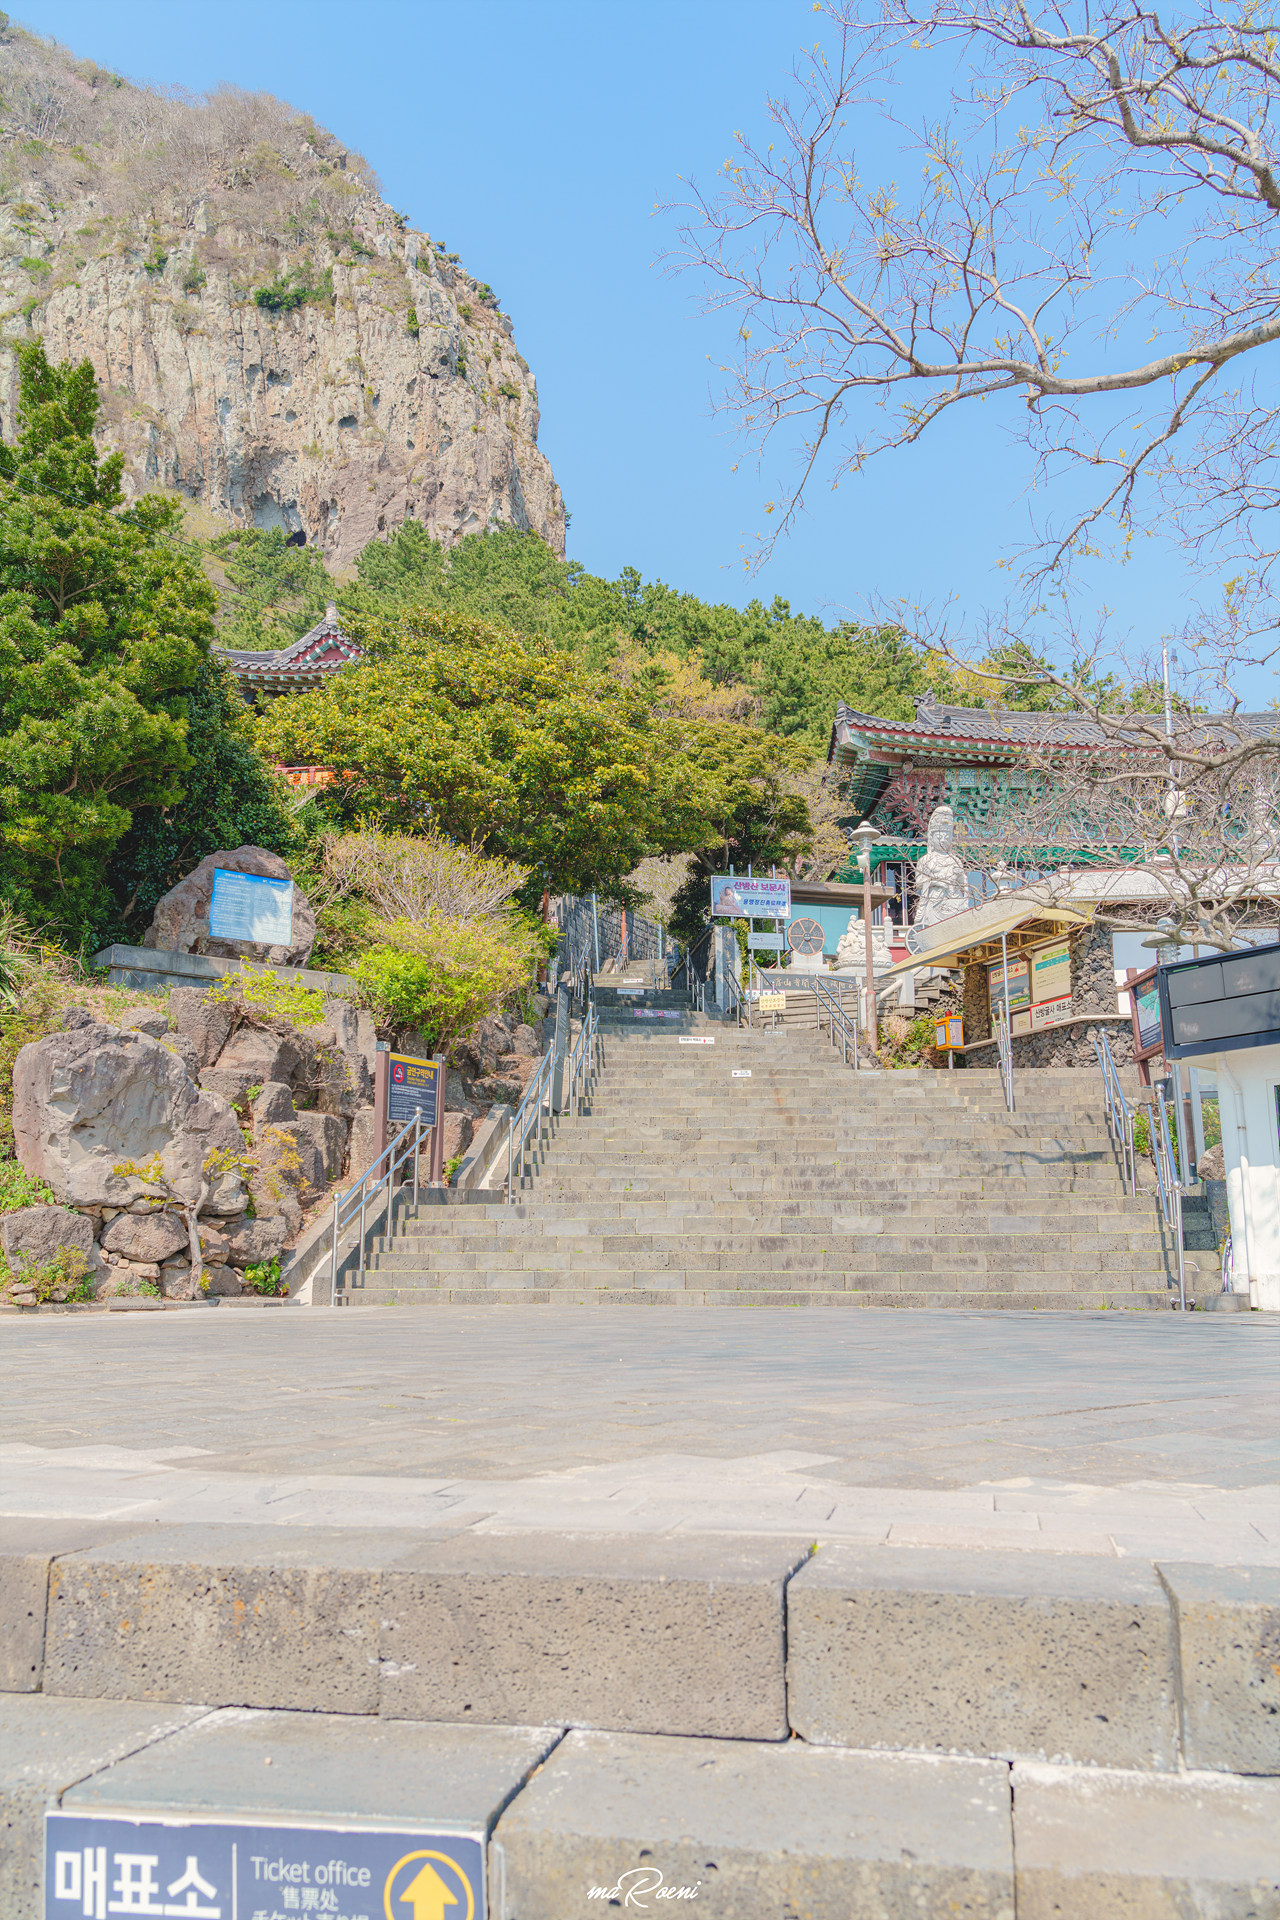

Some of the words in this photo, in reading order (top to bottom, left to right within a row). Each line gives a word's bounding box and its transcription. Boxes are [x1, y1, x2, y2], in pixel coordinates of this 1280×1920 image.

[734, 882, 758, 891] 산방산
[761, 883, 786, 892] 보문사
[1035, 1005, 1055, 1018] 산방굴사
[407, 1066, 434, 1080] 금연구역안내
[250, 1856, 311, 1883] Ticket
[315, 1860, 371, 1887] office
[55, 1847, 221, 1920] 매표소
[282, 1885, 339, 1911] 售票处
